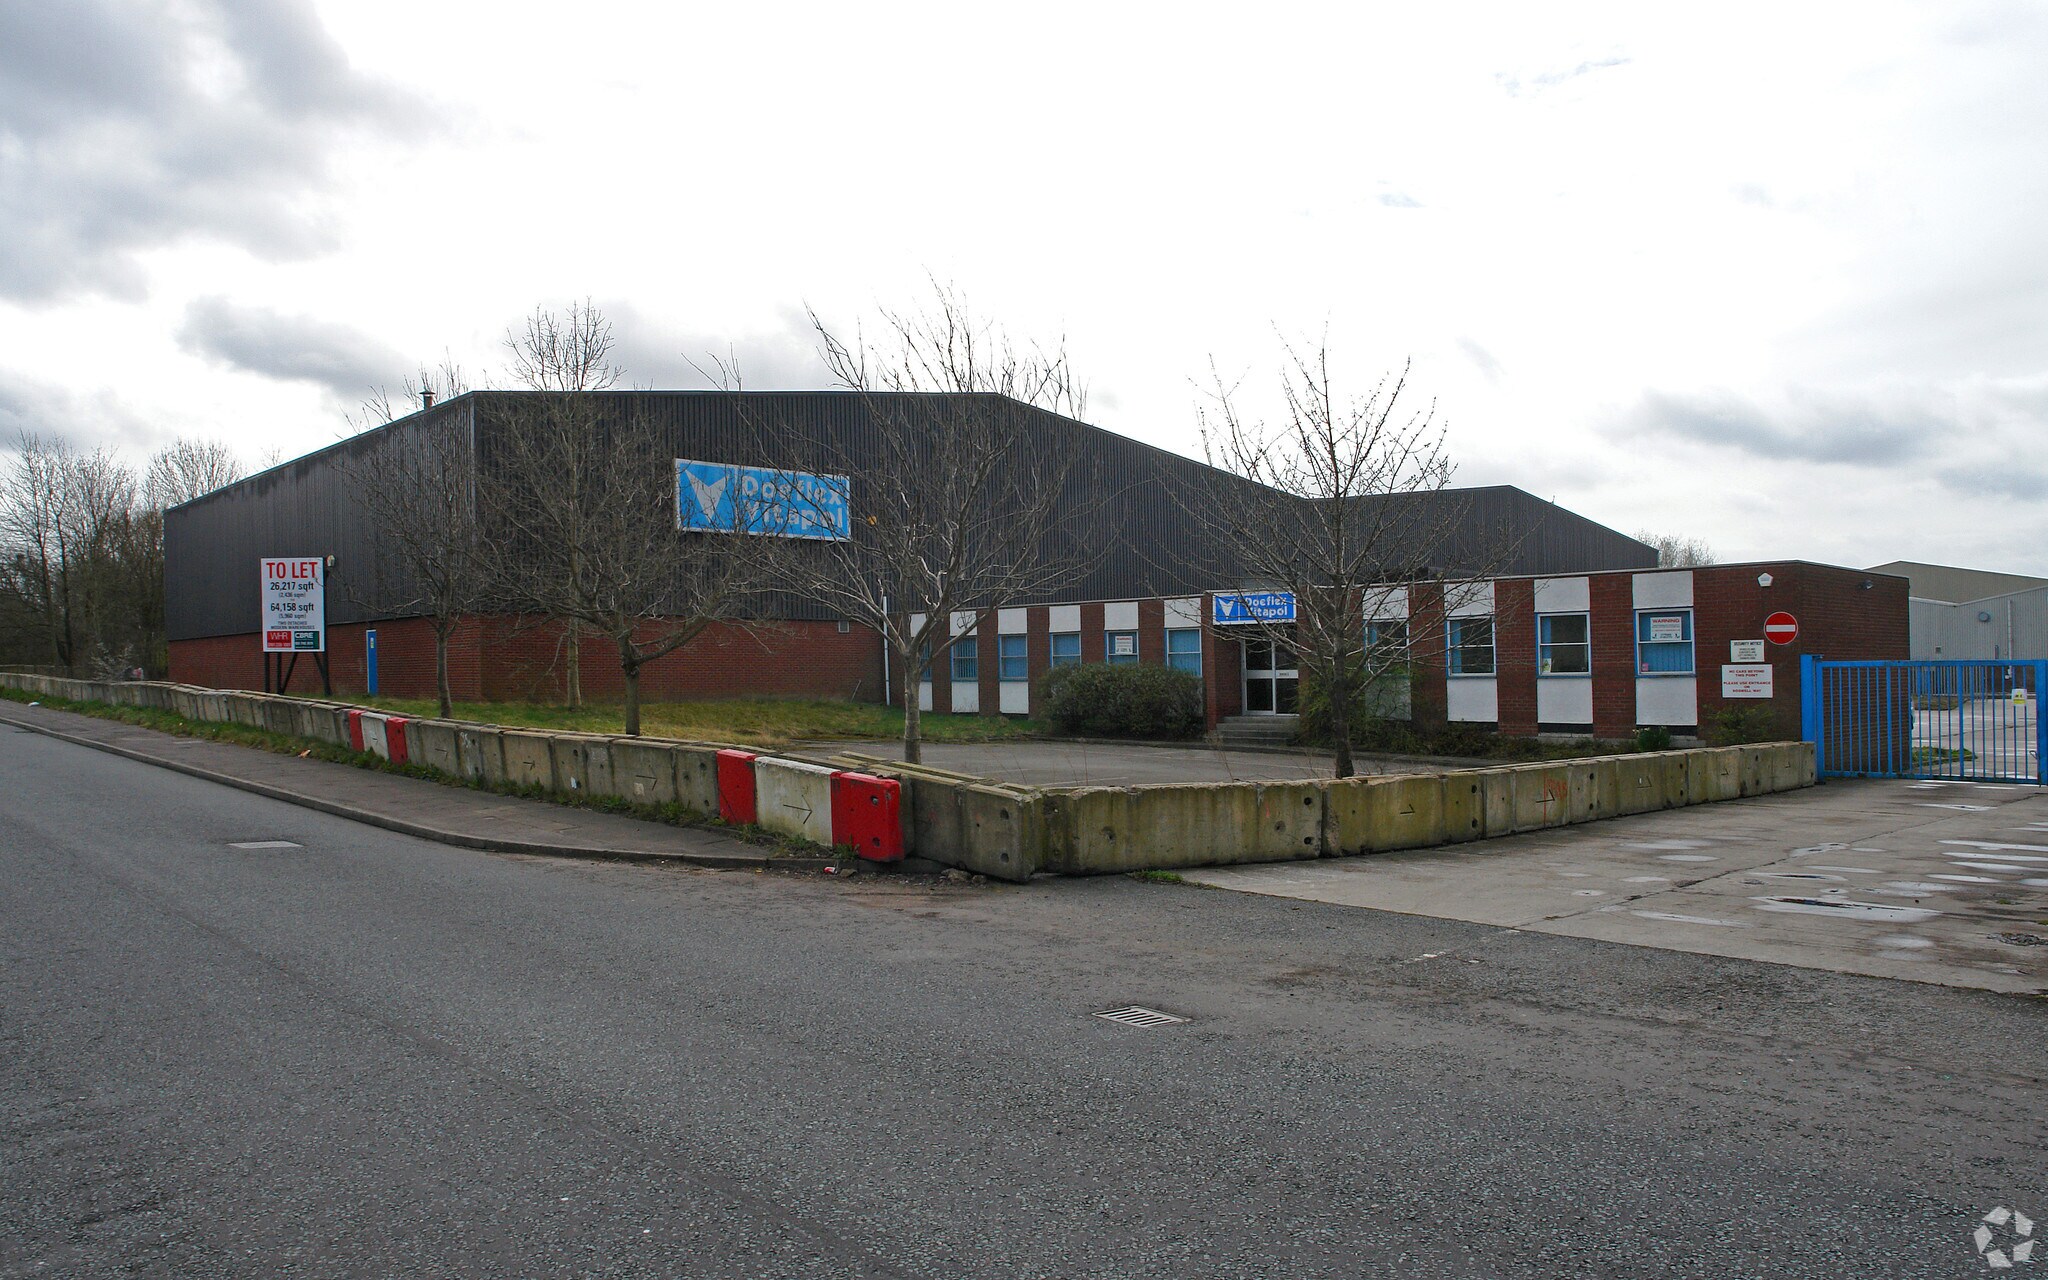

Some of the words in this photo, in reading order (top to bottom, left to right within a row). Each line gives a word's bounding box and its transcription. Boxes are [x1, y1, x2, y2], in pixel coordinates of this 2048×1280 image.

[741, 475, 842, 505] Doeflex
[743, 498, 843, 530] Vitapol
[266, 562, 287, 579] TO
[291, 561, 318, 579] LET
[270, 581, 296, 591] 26,217
[298, 581, 314, 592] sqft
[1245, 596, 1287, 607] Doeflex
[270, 602, 297, 612] 64,158
[298, 602, 314, 613] sqft
[270, 631, 289, 640] WHR
